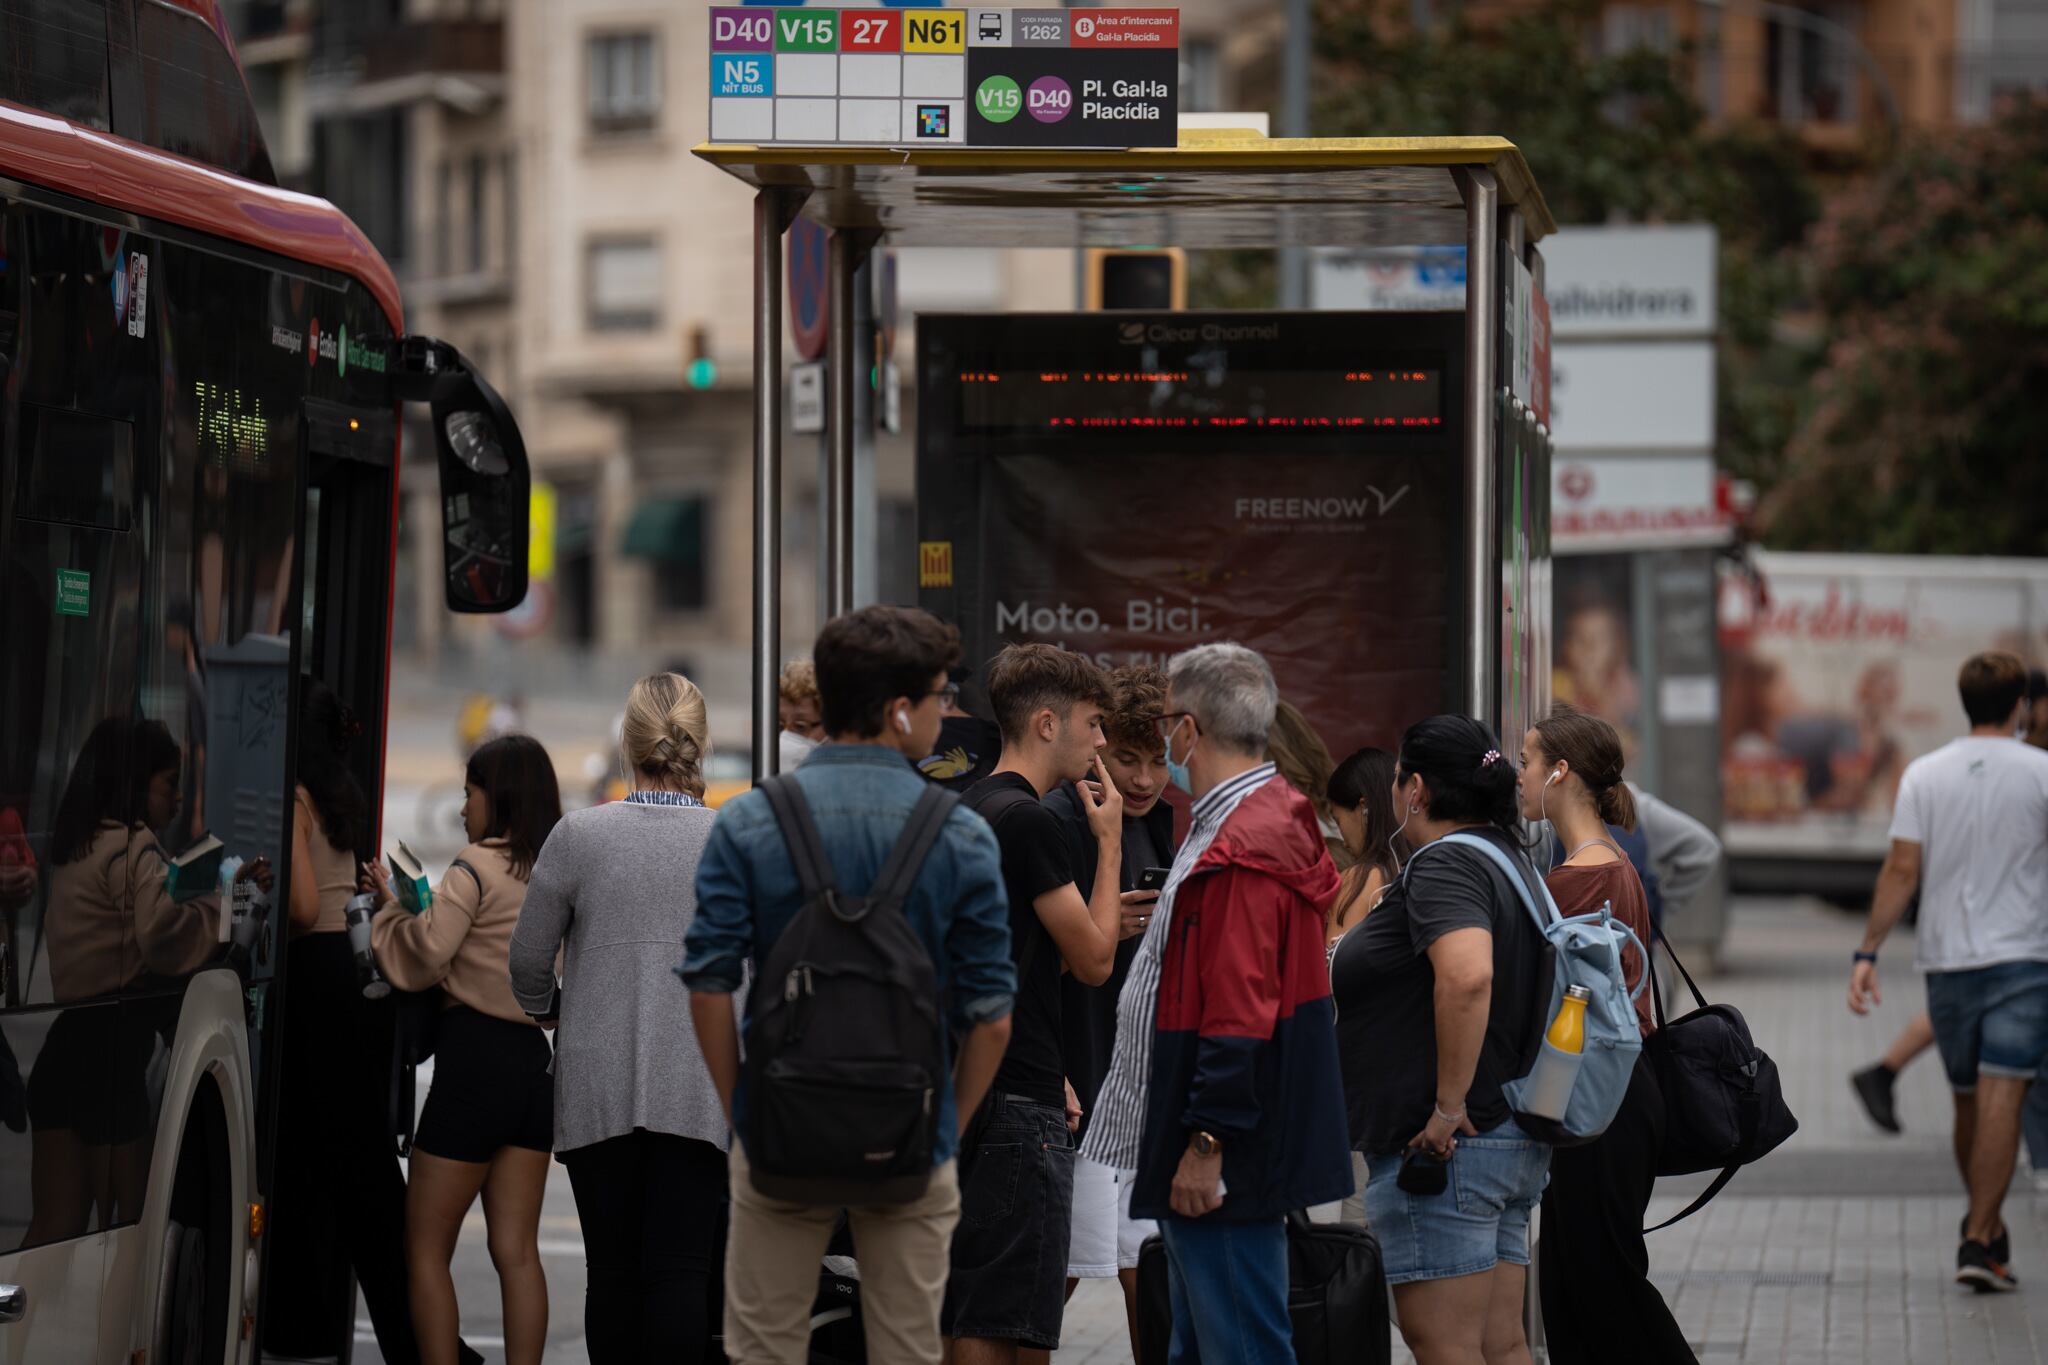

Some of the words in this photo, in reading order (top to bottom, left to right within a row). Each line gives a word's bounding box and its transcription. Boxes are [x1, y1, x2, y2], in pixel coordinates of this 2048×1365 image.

[715, 17, 771, 42] D40
[1096, 14, 1117, 25] Àrea
[1119, 15, 1173, 25] d'intercanvi
[779, 19, 833, 44] V15
[852, 19, 889, 44] 27
[908, 19, 960, 44] N61
[1021, 25, 1061, 40] 1262
[1096, 33, 1122, 42] Gal·la
[1123, 33, 1160, 42] Placídia
[724, 60, 759, 83] N5
[741, 84, 764, 94] BUS
[978, 89, 1018, 108] V15
[1029, 89, 1071, 108] D40
[1083, 80, 1106, 97] Pl.
[1112, 79, 1167, 98] Gal·la
[1083, 102, 1159, 120] Placídia
[1147, 323, 1197, 342] Clear
[1200, 321, 1279, 342] Channel
[1234, 497, 1368, 520] FREENOW
[996, 600, 1110, 635] Moto.
[1127, 596, 1213, 633] Bici.
